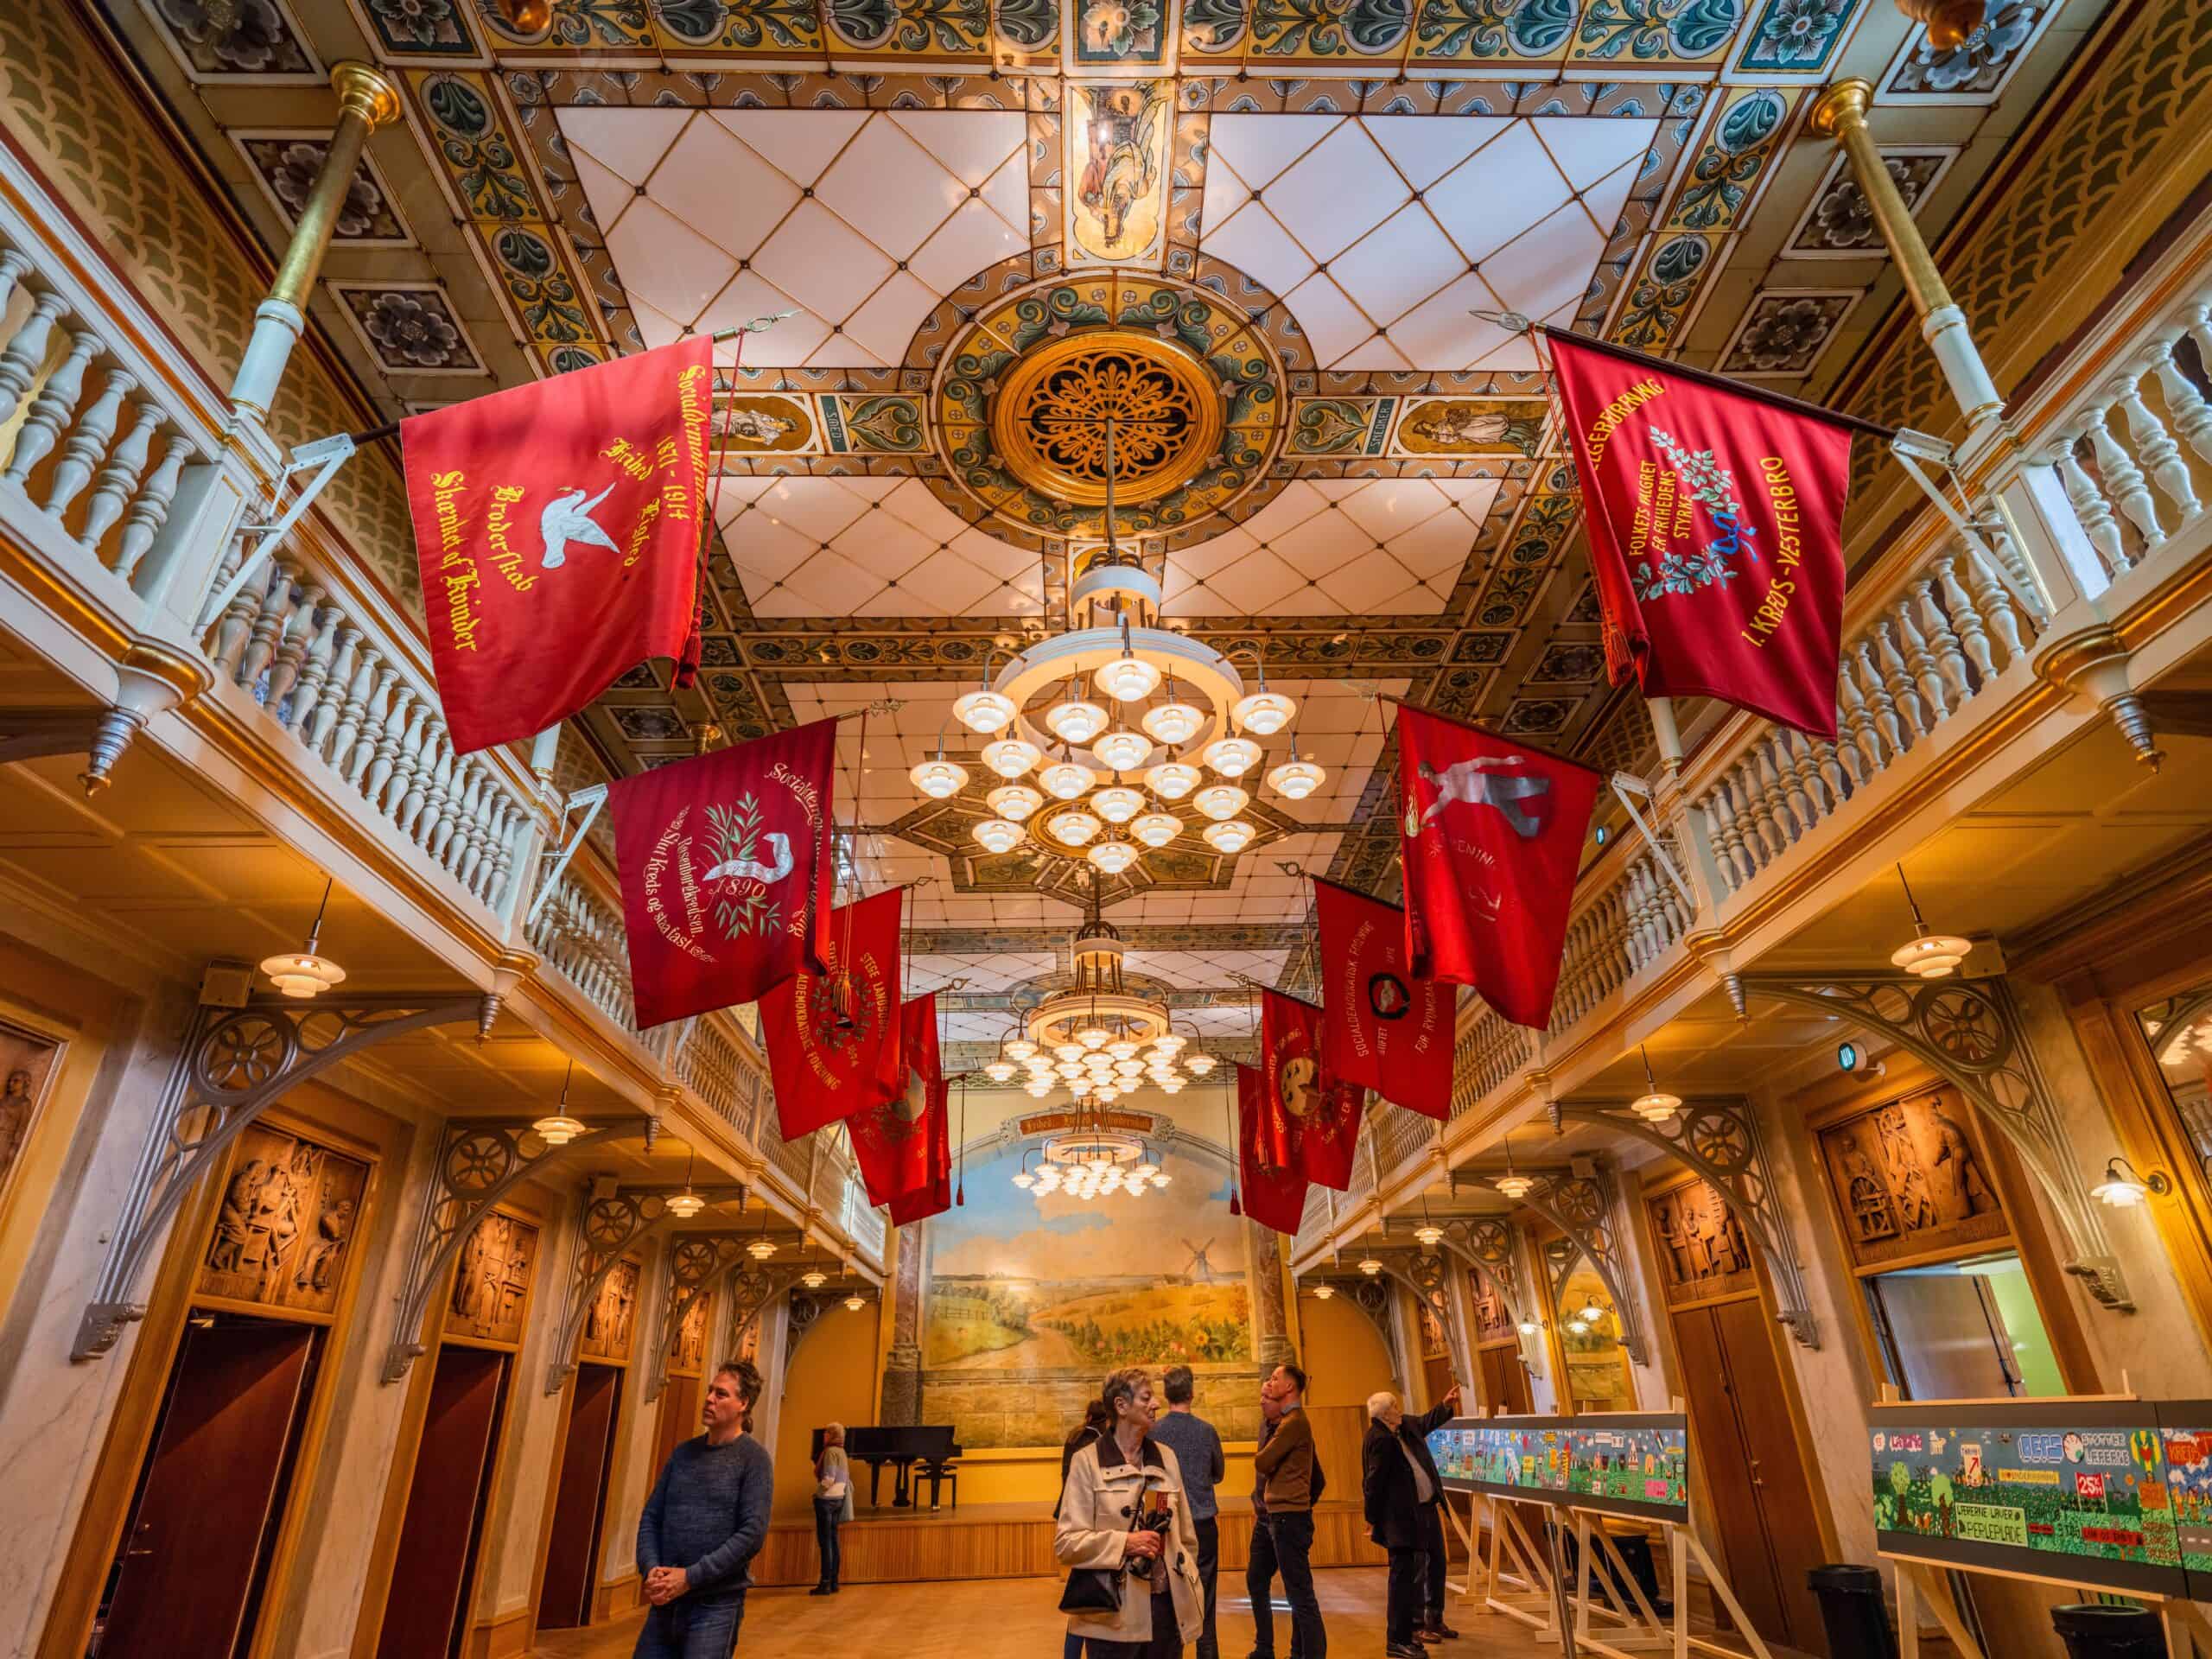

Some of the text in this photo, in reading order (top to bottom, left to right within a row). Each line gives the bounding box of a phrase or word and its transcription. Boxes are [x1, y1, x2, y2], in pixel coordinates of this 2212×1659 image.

[656, 435, 678, 469] 1871
[663, 485, 690, 520] 1914
[1651, 470, 1676, 553] ER FRIHEDENS
[1673, 493, 1694, 539] STYRKE
[1760, 455, 1801, 569] VESTERBRO
[1629, 506, 1650, 556] FOLKETS
[1751, 579, 1797, 637] KREDS
[643, 857, 669, 896] Kreds
[647, 899, 664, 912] og
[2078, 1477, 2094, 1495] 25
